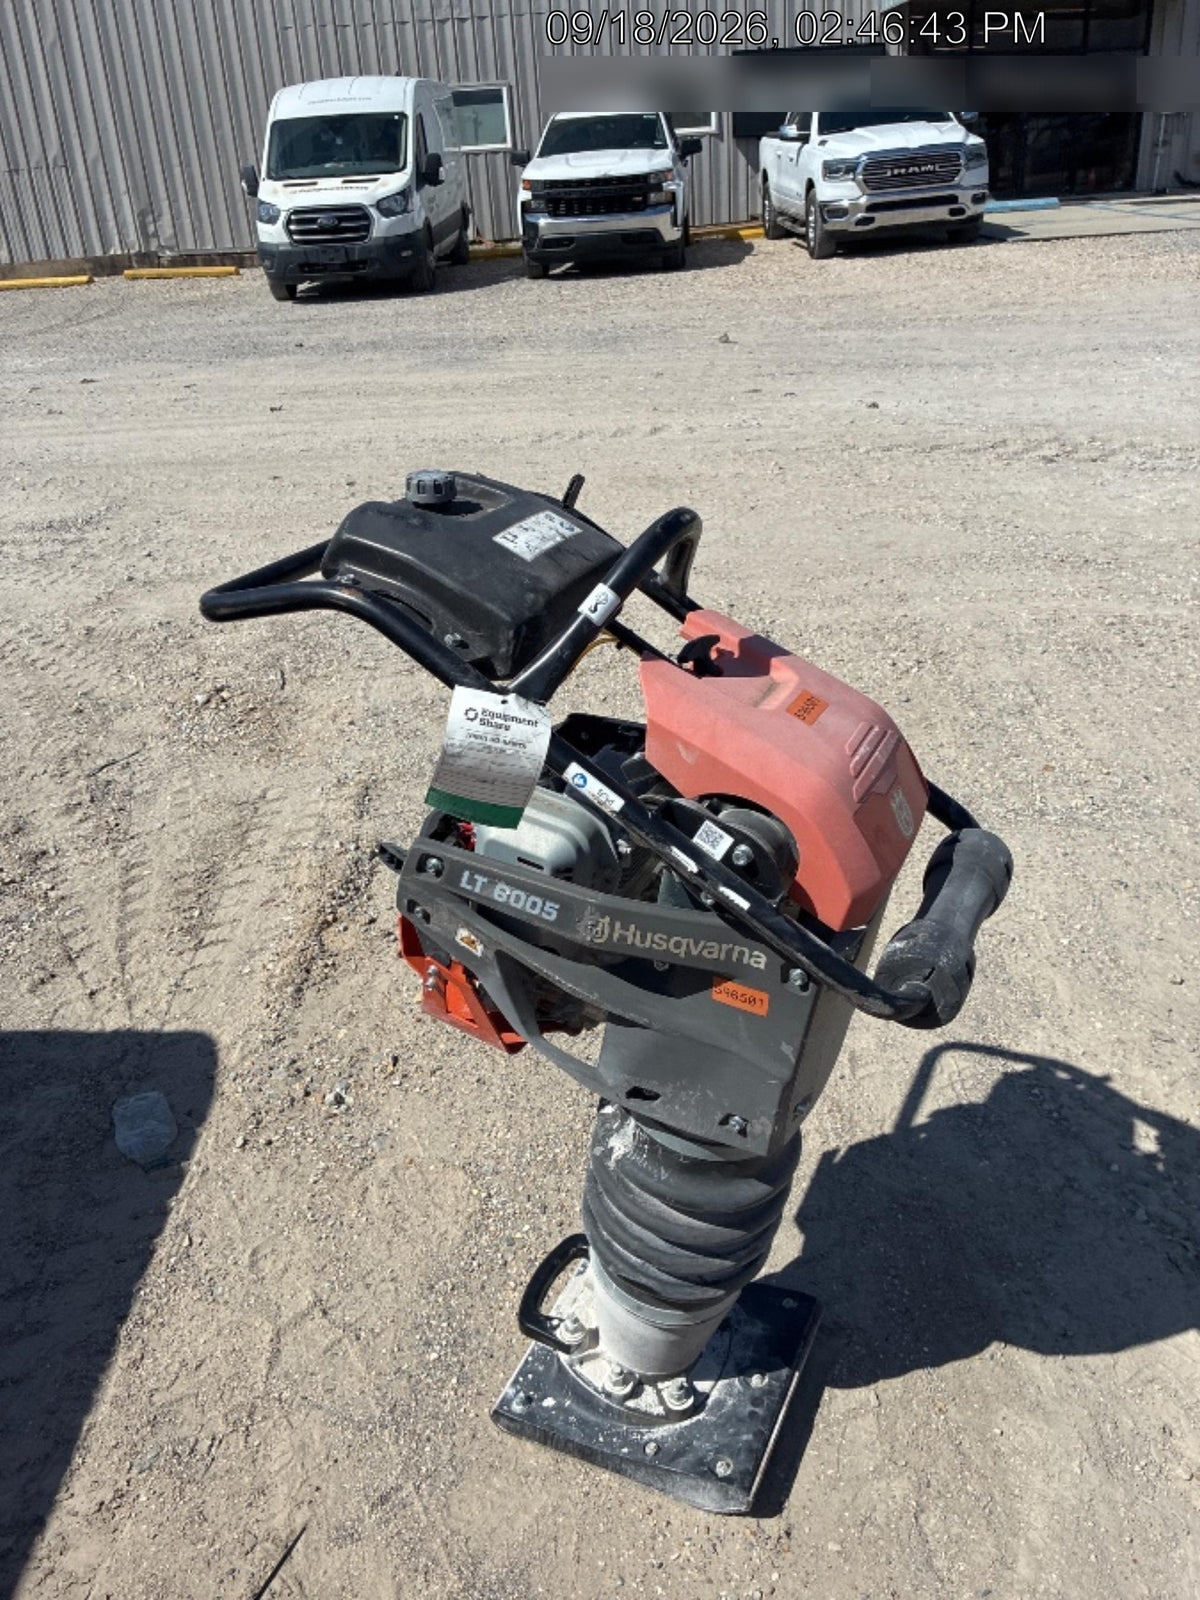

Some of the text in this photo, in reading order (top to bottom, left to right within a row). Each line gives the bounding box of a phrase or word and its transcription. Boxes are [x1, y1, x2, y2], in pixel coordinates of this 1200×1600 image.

[893, 164, 935, 175] RAM
[479, 718, 511, 731] Share
[481, 708, 539, 728] Equipment
[459, 870, 561, 922] LT 6005
[613, 920, 768, 970] Husqvarna
